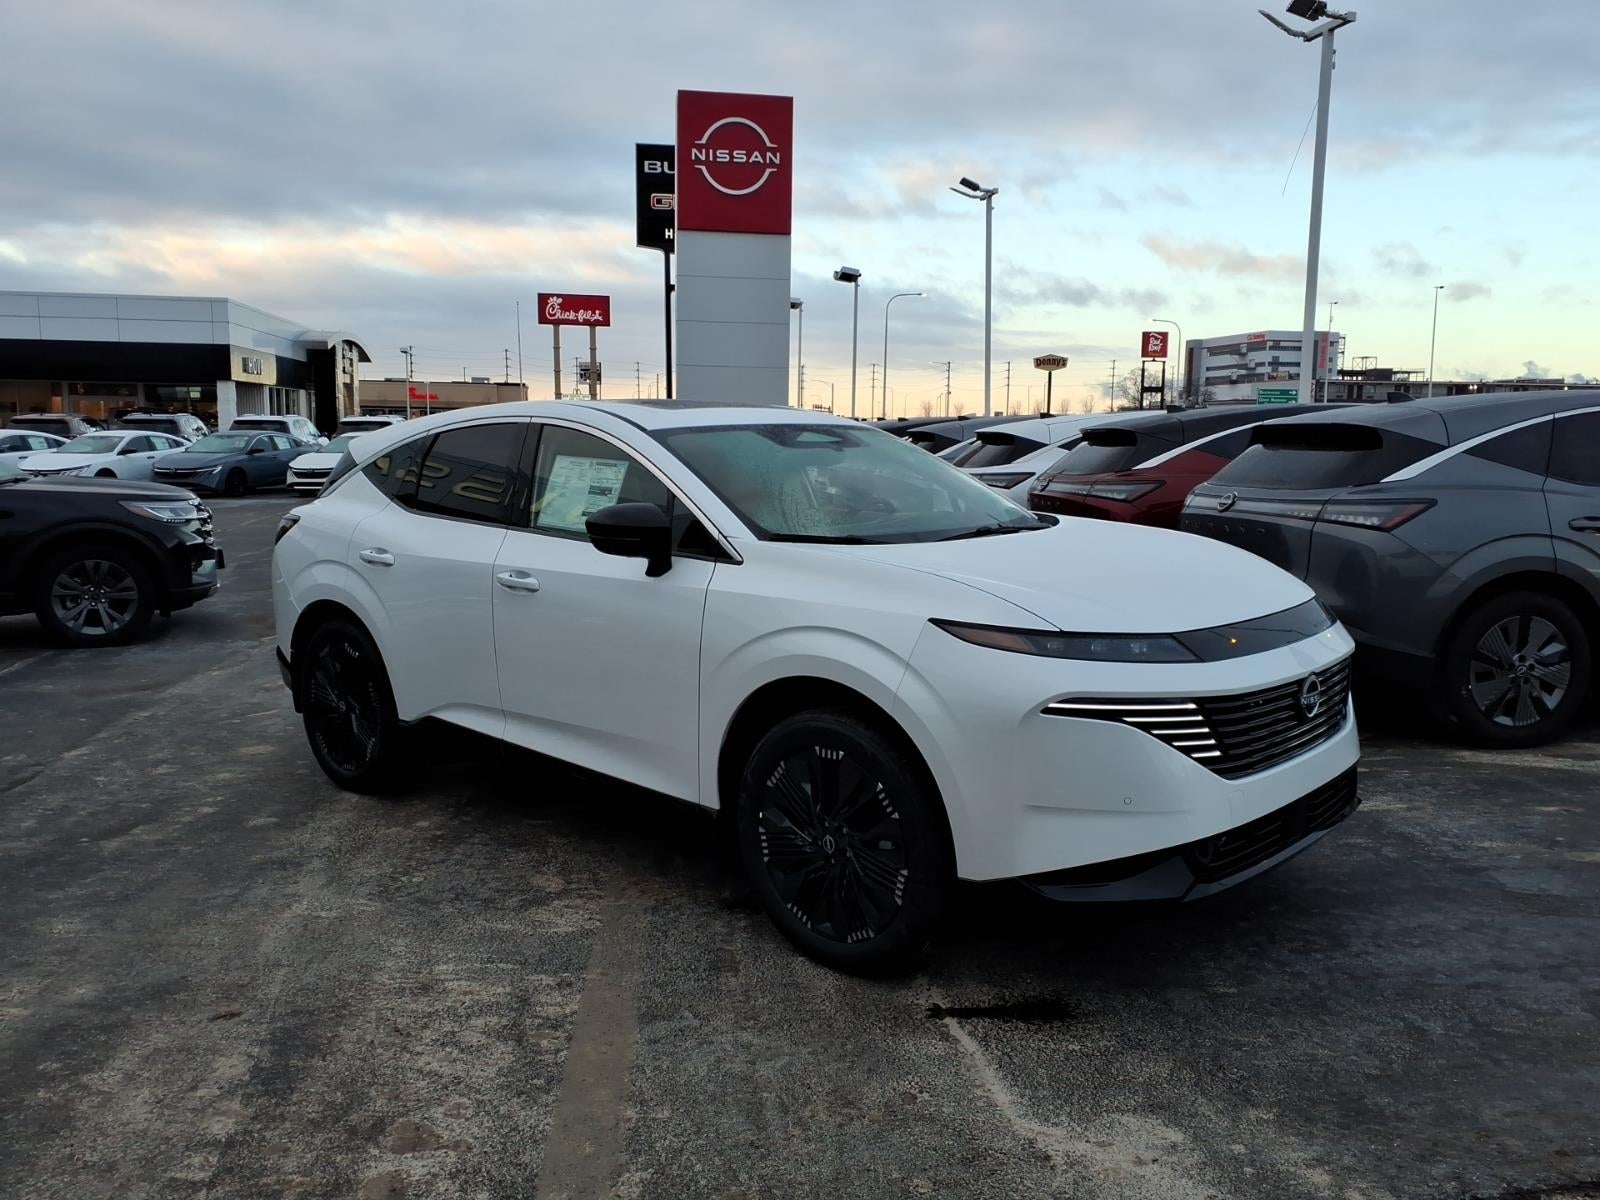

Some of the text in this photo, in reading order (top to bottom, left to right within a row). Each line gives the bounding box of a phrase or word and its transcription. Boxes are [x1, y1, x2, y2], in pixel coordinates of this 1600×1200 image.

[691, 148, 780, 164] NISSAN
[651, 193, 675, 210] G
[1036, 358, 1067, 367] Denny's
[1300, 695, 1320, 704] NISS
